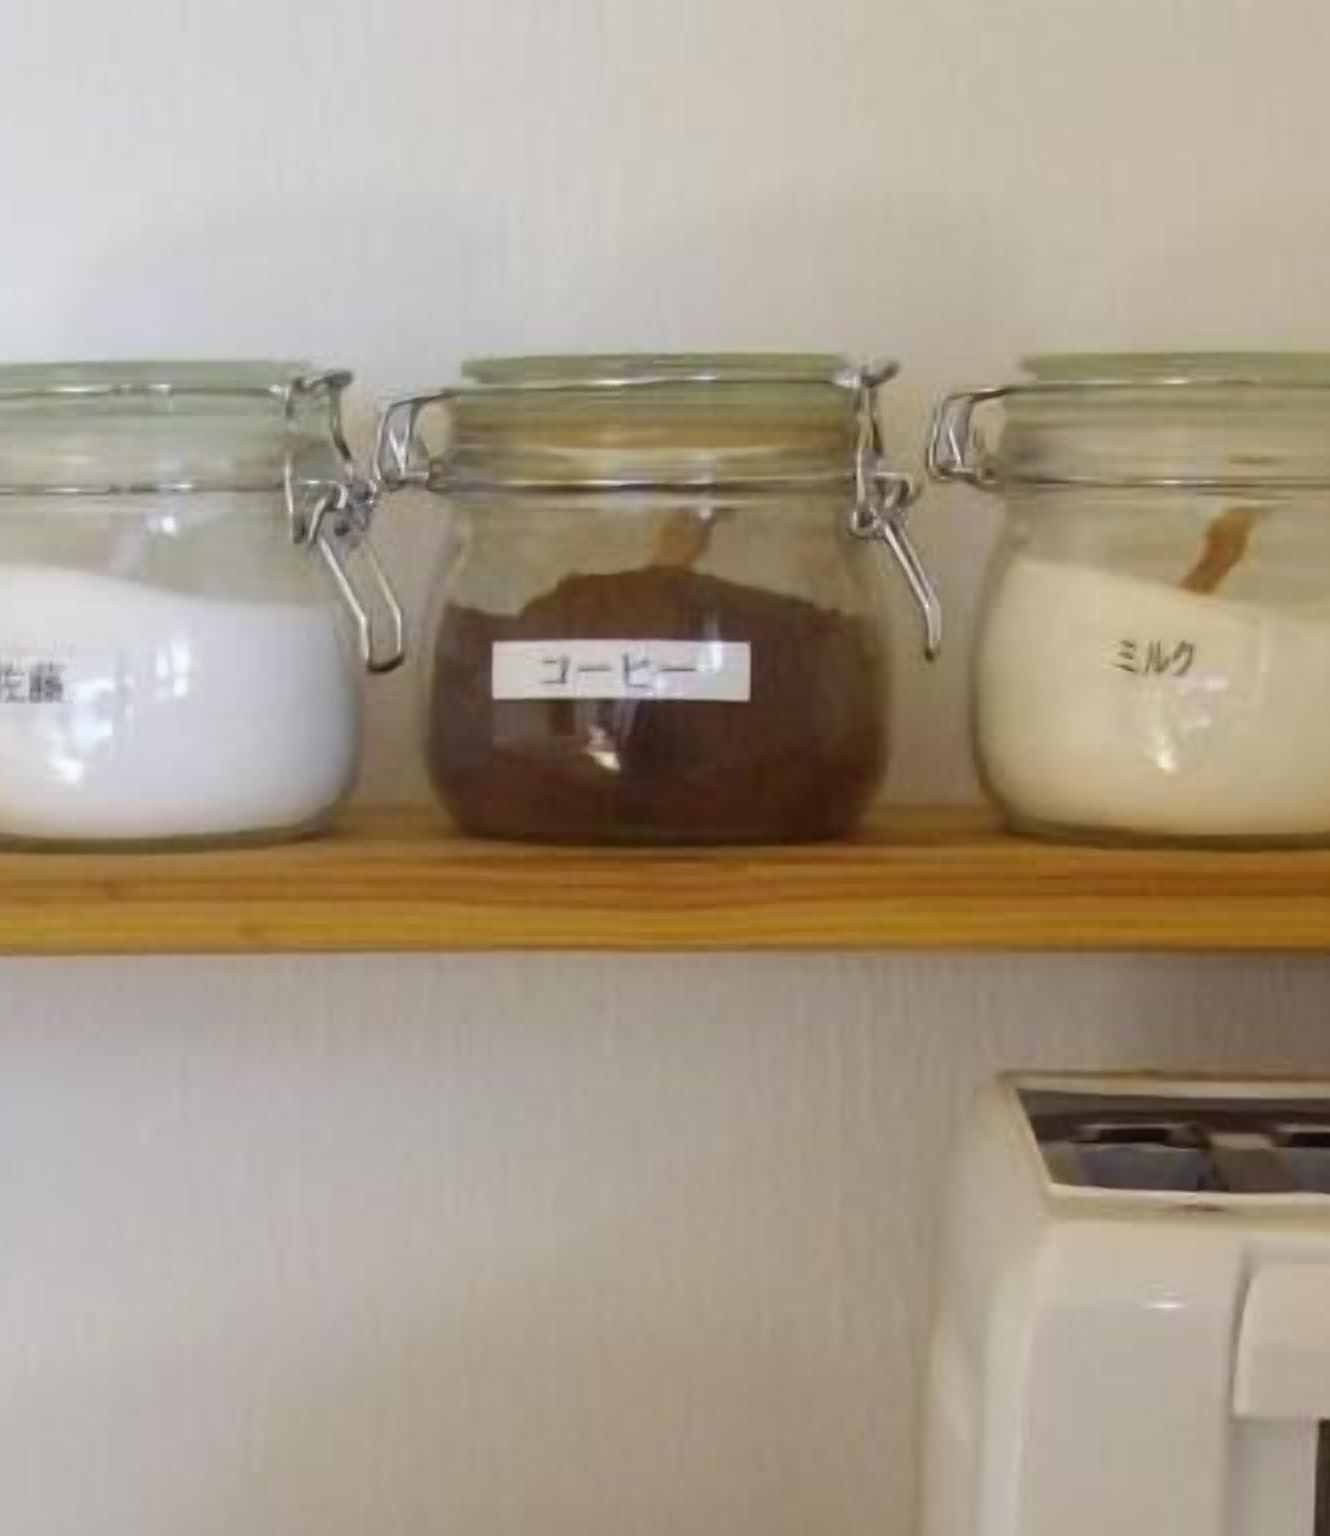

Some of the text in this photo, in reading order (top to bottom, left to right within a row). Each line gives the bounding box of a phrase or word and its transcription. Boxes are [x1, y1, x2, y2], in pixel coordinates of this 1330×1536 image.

[539, 652, 698, 690] コーヒー
[1116, 639, 1195, 678] ミルク
